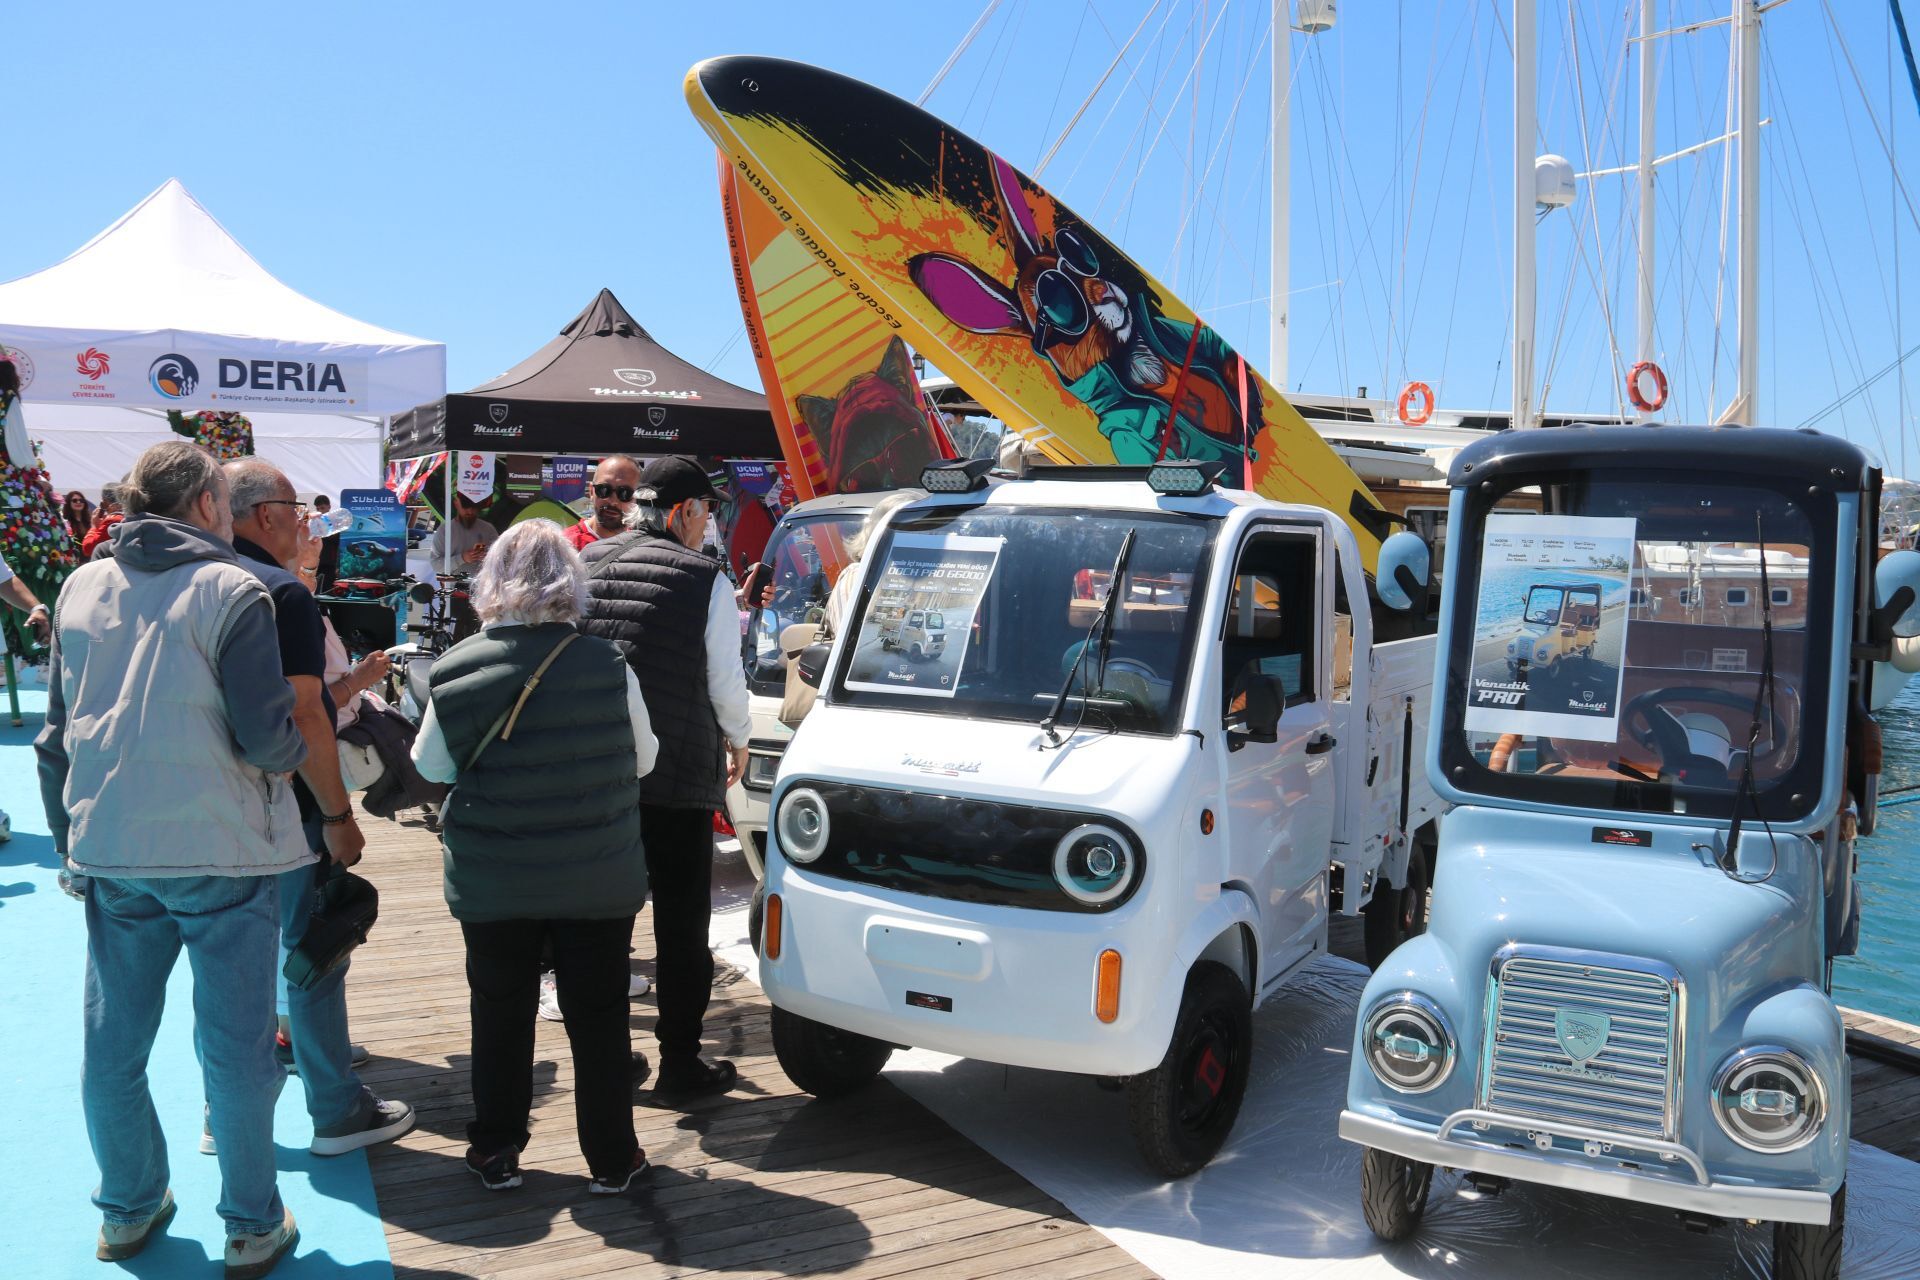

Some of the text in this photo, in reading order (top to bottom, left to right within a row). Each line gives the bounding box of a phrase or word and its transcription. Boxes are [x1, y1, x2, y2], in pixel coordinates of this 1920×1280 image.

[737, 155, 902, 330] Escape. Paddle. Breathe.
[589, 387, 698, 397] Musatti
[473, 423, 523, 433] Musatti
[633, 426, 679, 437] Musatti
[463, 470, 490, 480] SYM
[508, 472, 540, 480] Kawasaki
[888, 566, 919, 577] DOCH
[920, 568, 945, 578] PRO
[1474, 678, 1531, 691] Venedik
[1477, 690, 1526, 705] PRO
[1568, 698, 1607, 709] Musatti
